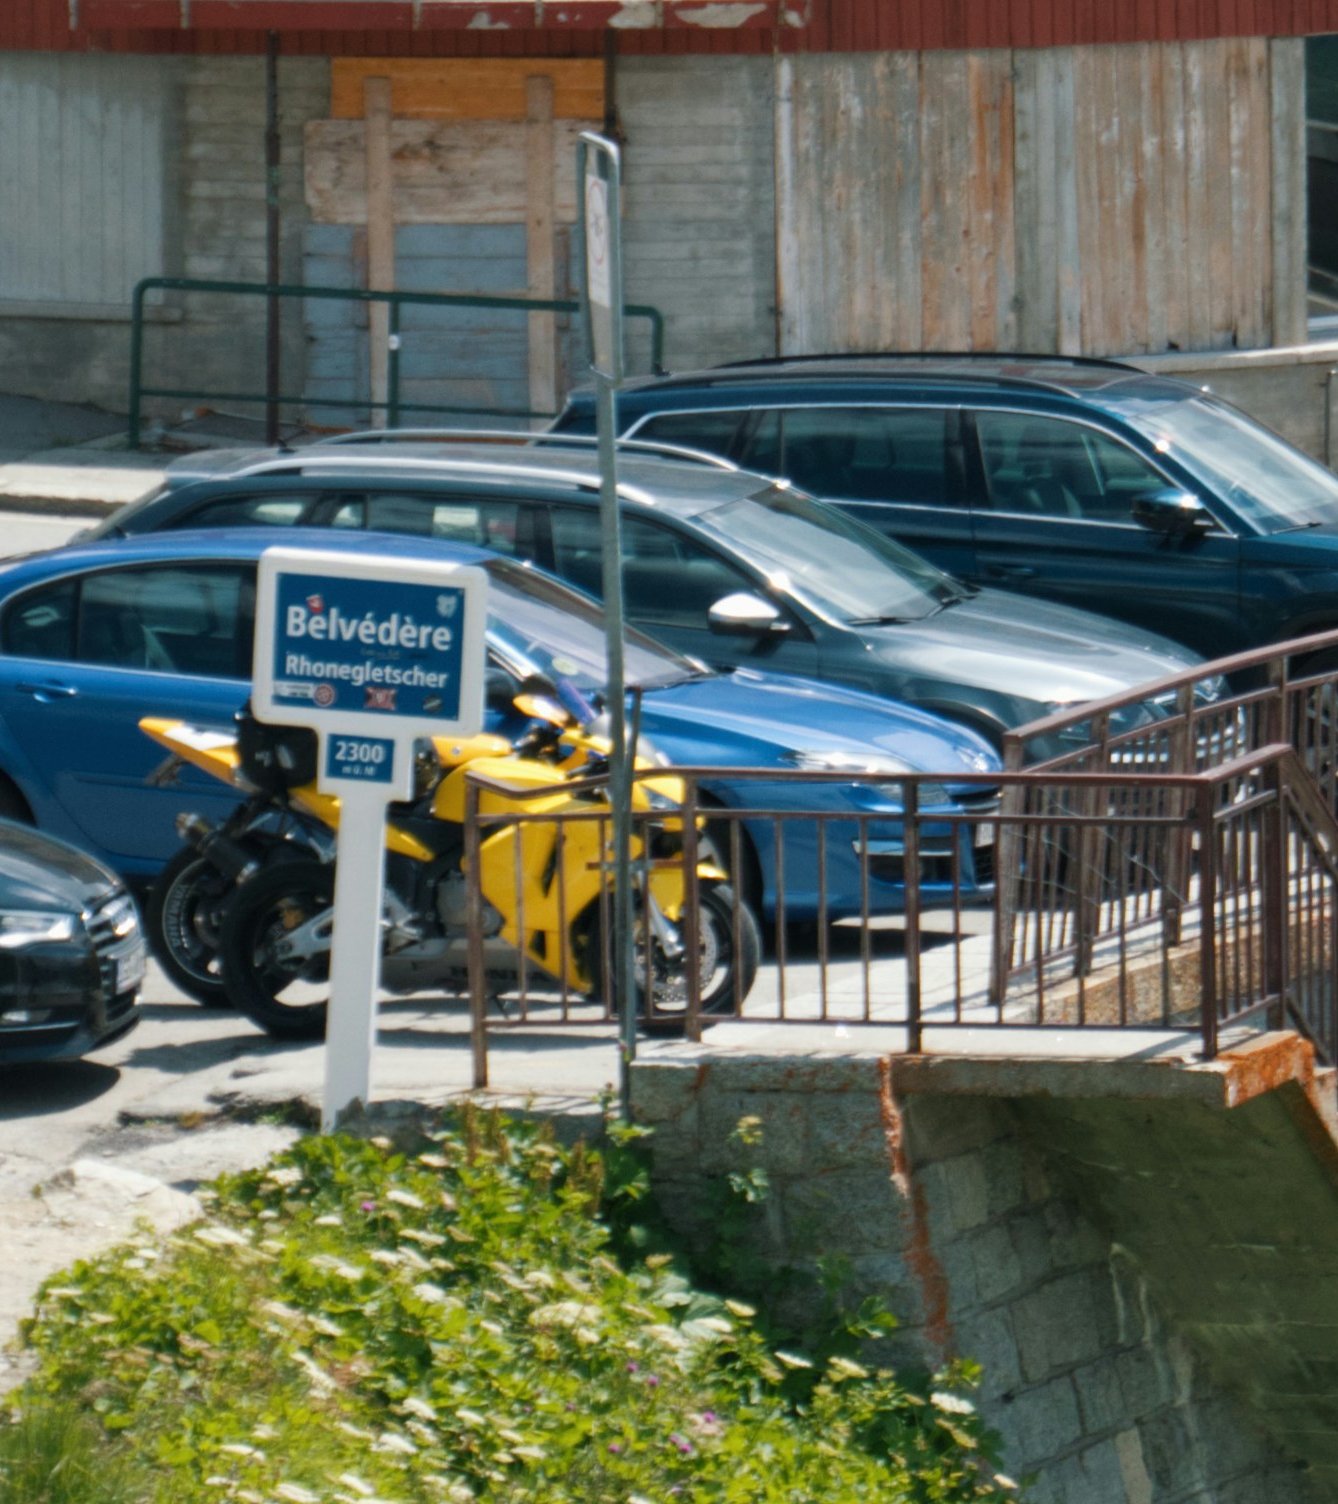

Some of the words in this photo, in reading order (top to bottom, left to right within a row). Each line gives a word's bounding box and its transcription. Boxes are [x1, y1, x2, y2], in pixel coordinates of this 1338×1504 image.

[286, 605, 452, 651] Belvédère
[285, 653, 448, 687] Rhonegletscher
[334, 740, 384, 764] 2300
